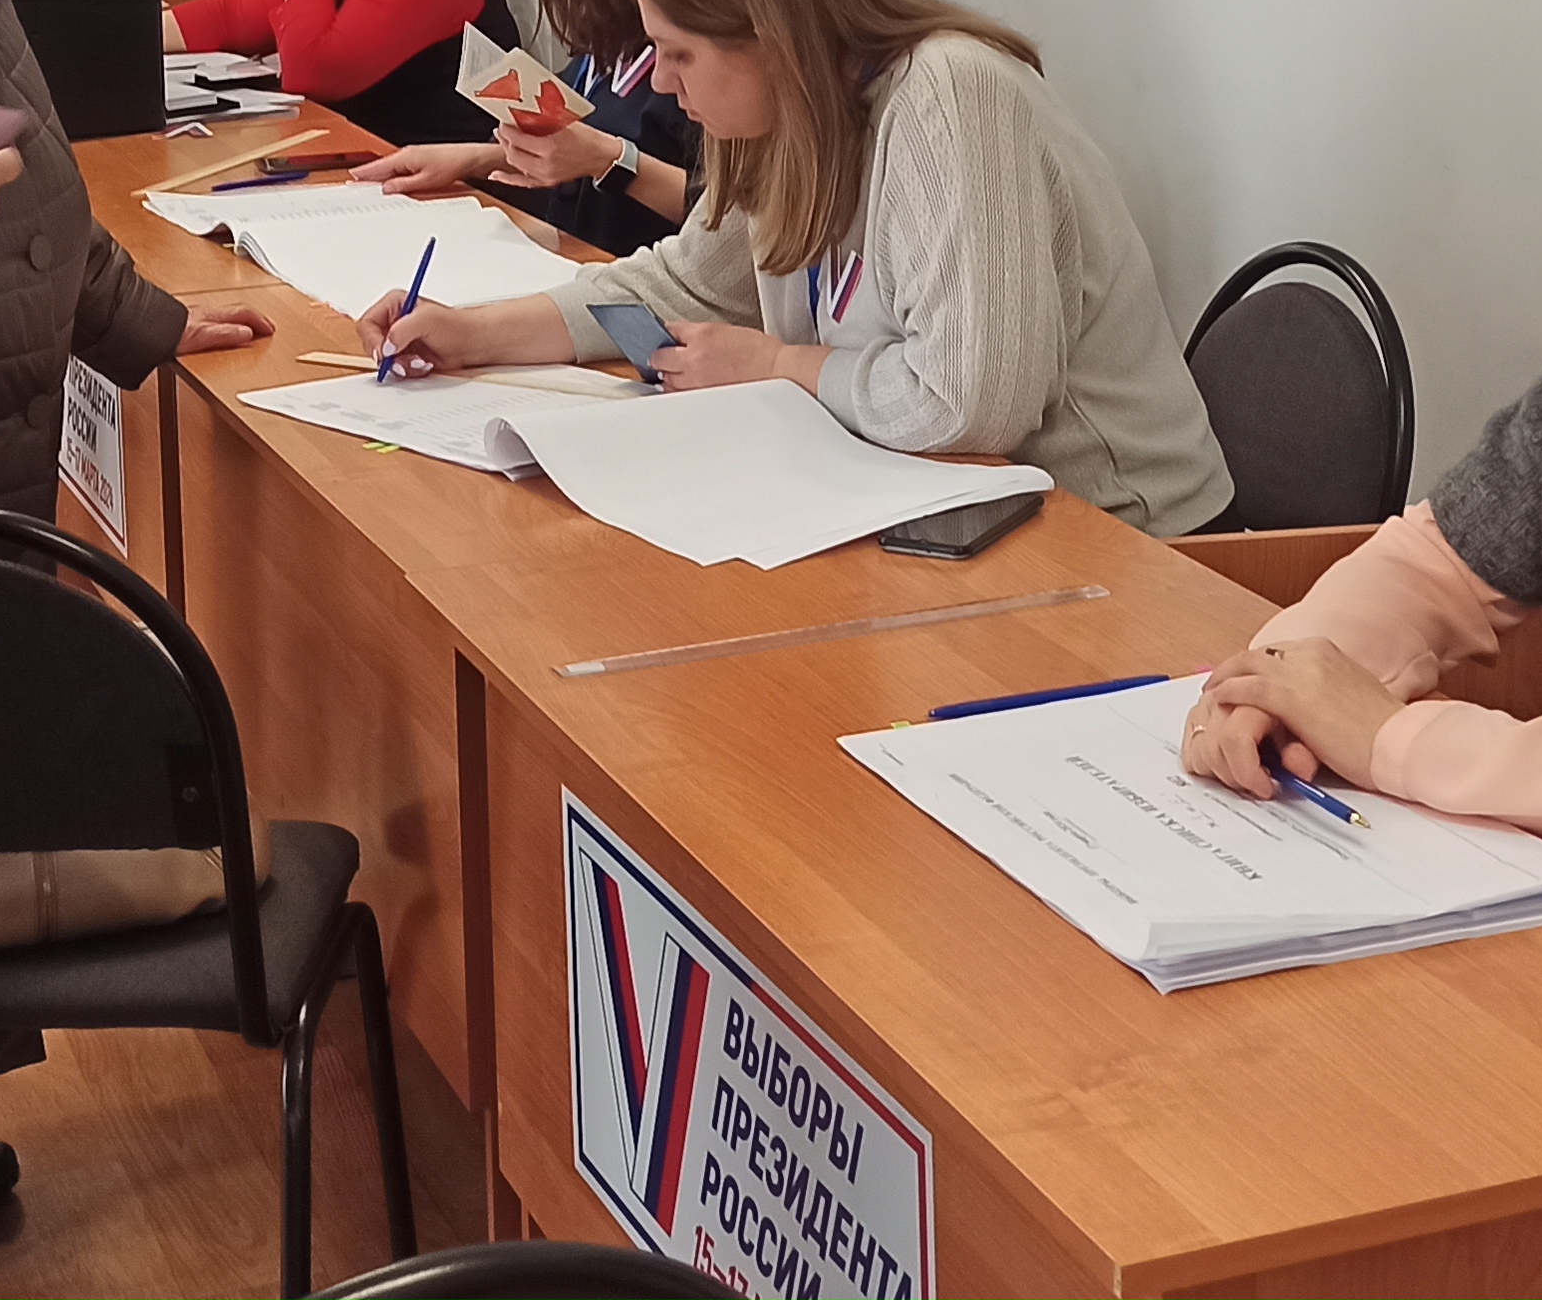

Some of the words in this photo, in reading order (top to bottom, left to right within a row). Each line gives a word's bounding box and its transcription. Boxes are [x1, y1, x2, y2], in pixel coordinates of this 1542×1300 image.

[68, 355, 116, 431] ПРЕЗИДЕНТА
[67, 397, 98, 453] РОССИИ
[81, 457, 100, 495] МАРТА
[99, 474, 114, 512] 2024
[1065, 754, 1160, 813] ИЗБИРАТЕЛЕЙ
[1157, 811, 1217, 849] СПИСКА
[1211, 846, 1263, 881] КНИГА
[722, 997, 865, 1185] ВЫБОРЫ
[700, 1151, 822, 1300] РОССИИ
